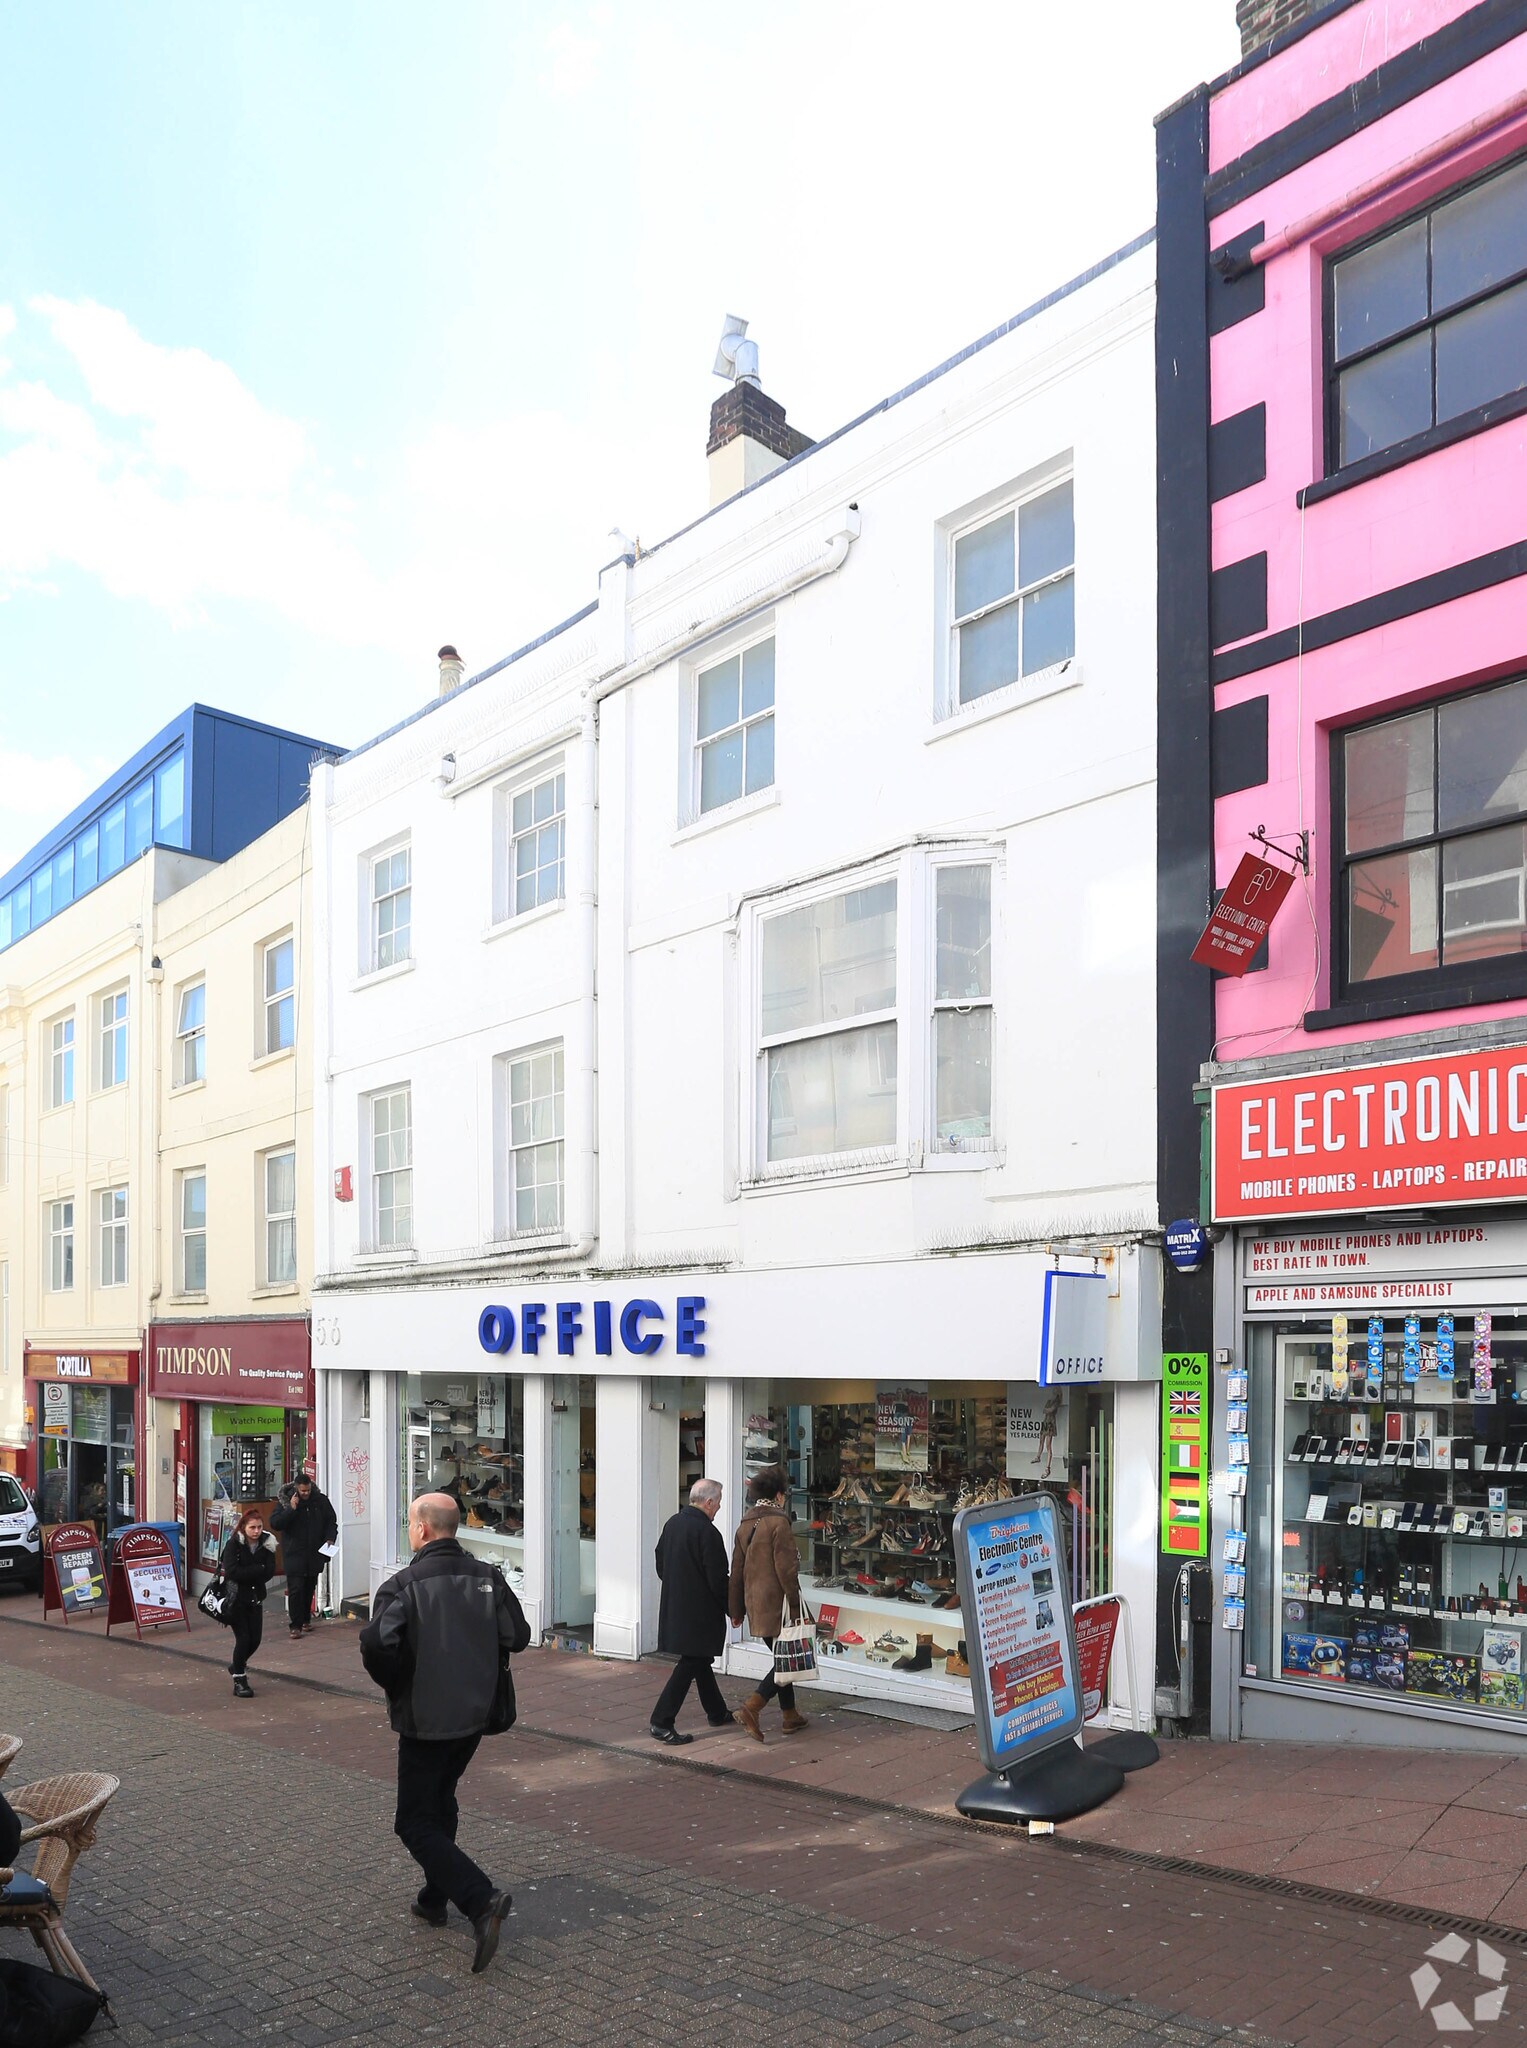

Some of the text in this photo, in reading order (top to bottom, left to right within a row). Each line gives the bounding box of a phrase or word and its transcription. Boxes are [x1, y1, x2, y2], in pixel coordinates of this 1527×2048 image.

[1241, 1064, 1527, 1160] ELECTRONIC
[1240, 1178, 1293, 1200] MOBILE
[1297, 1172, 1356, 1195] PHONES
[1372, 1164, 1446, 1189] LAPTOPS
[1166, 1229, 1201, 1245] MATRIX
[1253, 1228, 1488, 1255] WE BUY MOBILE PHONES AND LAPTOPS.
[1253, 1253, 1370, 1271] BEST RATE IN TOWN.
[1255, 1282, 1453, 1302] APPLE AND SAMSUNG SPECIALIST
[478, 1296, 706, 1357] OFFICE
[56, 1356, 93, 1377] TORTILLA
[156, 1346, 232, 1377] TIMPSON
[1055, 1358, 1104, 1375] OFFICE
[1168, 1357, 1202, 1375] 0%
[238, 1368, 304, 1380] The Quality Service People
[878, 1404, 897, 1414] NEW
[1010, 1408, 1033, 1419] NEW
[230, 1417, 256, 1425] Watch
[878, 1415, 914, 1427] SEASON?
[55, 1529, 91, 1544] TIMPSON
[990, 1523, 1030, 1539] Brighton
[126, 1534, 164, 1549] TIMPSON
[979, 1533, 1043, 1562] Electronic Centre
[62, 1552, 92, 1563] SCREEN
[63, 1559, 94, 1569] REPAIRS
[1002, 1561, 1018, 1570] SONY
[1029, 1552, 1039, 1564] LG
[133, 1566, 172, 1578] SECURITY
[152, 1574, 173, 1582] KEYS
[977, 1575, 1016, 1594] LAPTOP REPAIRS
[821, 1614, 835, 1623] SALE
[985, 1606, 1026, 1628] Screen Replacement
[1077, 1617, 1093, 1631] PHONE
[986, 1617, 1028, 1639] Complete Diagnostic
[988, 1633, 1017, 1650] Data Recovery
[1016, 1670, 1055, 1693] We buy Mobile
[1013, 1691, 1034, 1705] Phones
[1039, 1681, 1060, 1695] Laptops
[994, 1700, 1008, 1709] Access
[1007, 1700, 1058, 1729] COMPETITIVE PRICES
[1004, 1729, 1017, 1743] FAST
[1021, 1718, 1044, 1736] RELIABLE
[1044, 1708, 1064, 1725] SERVICE
